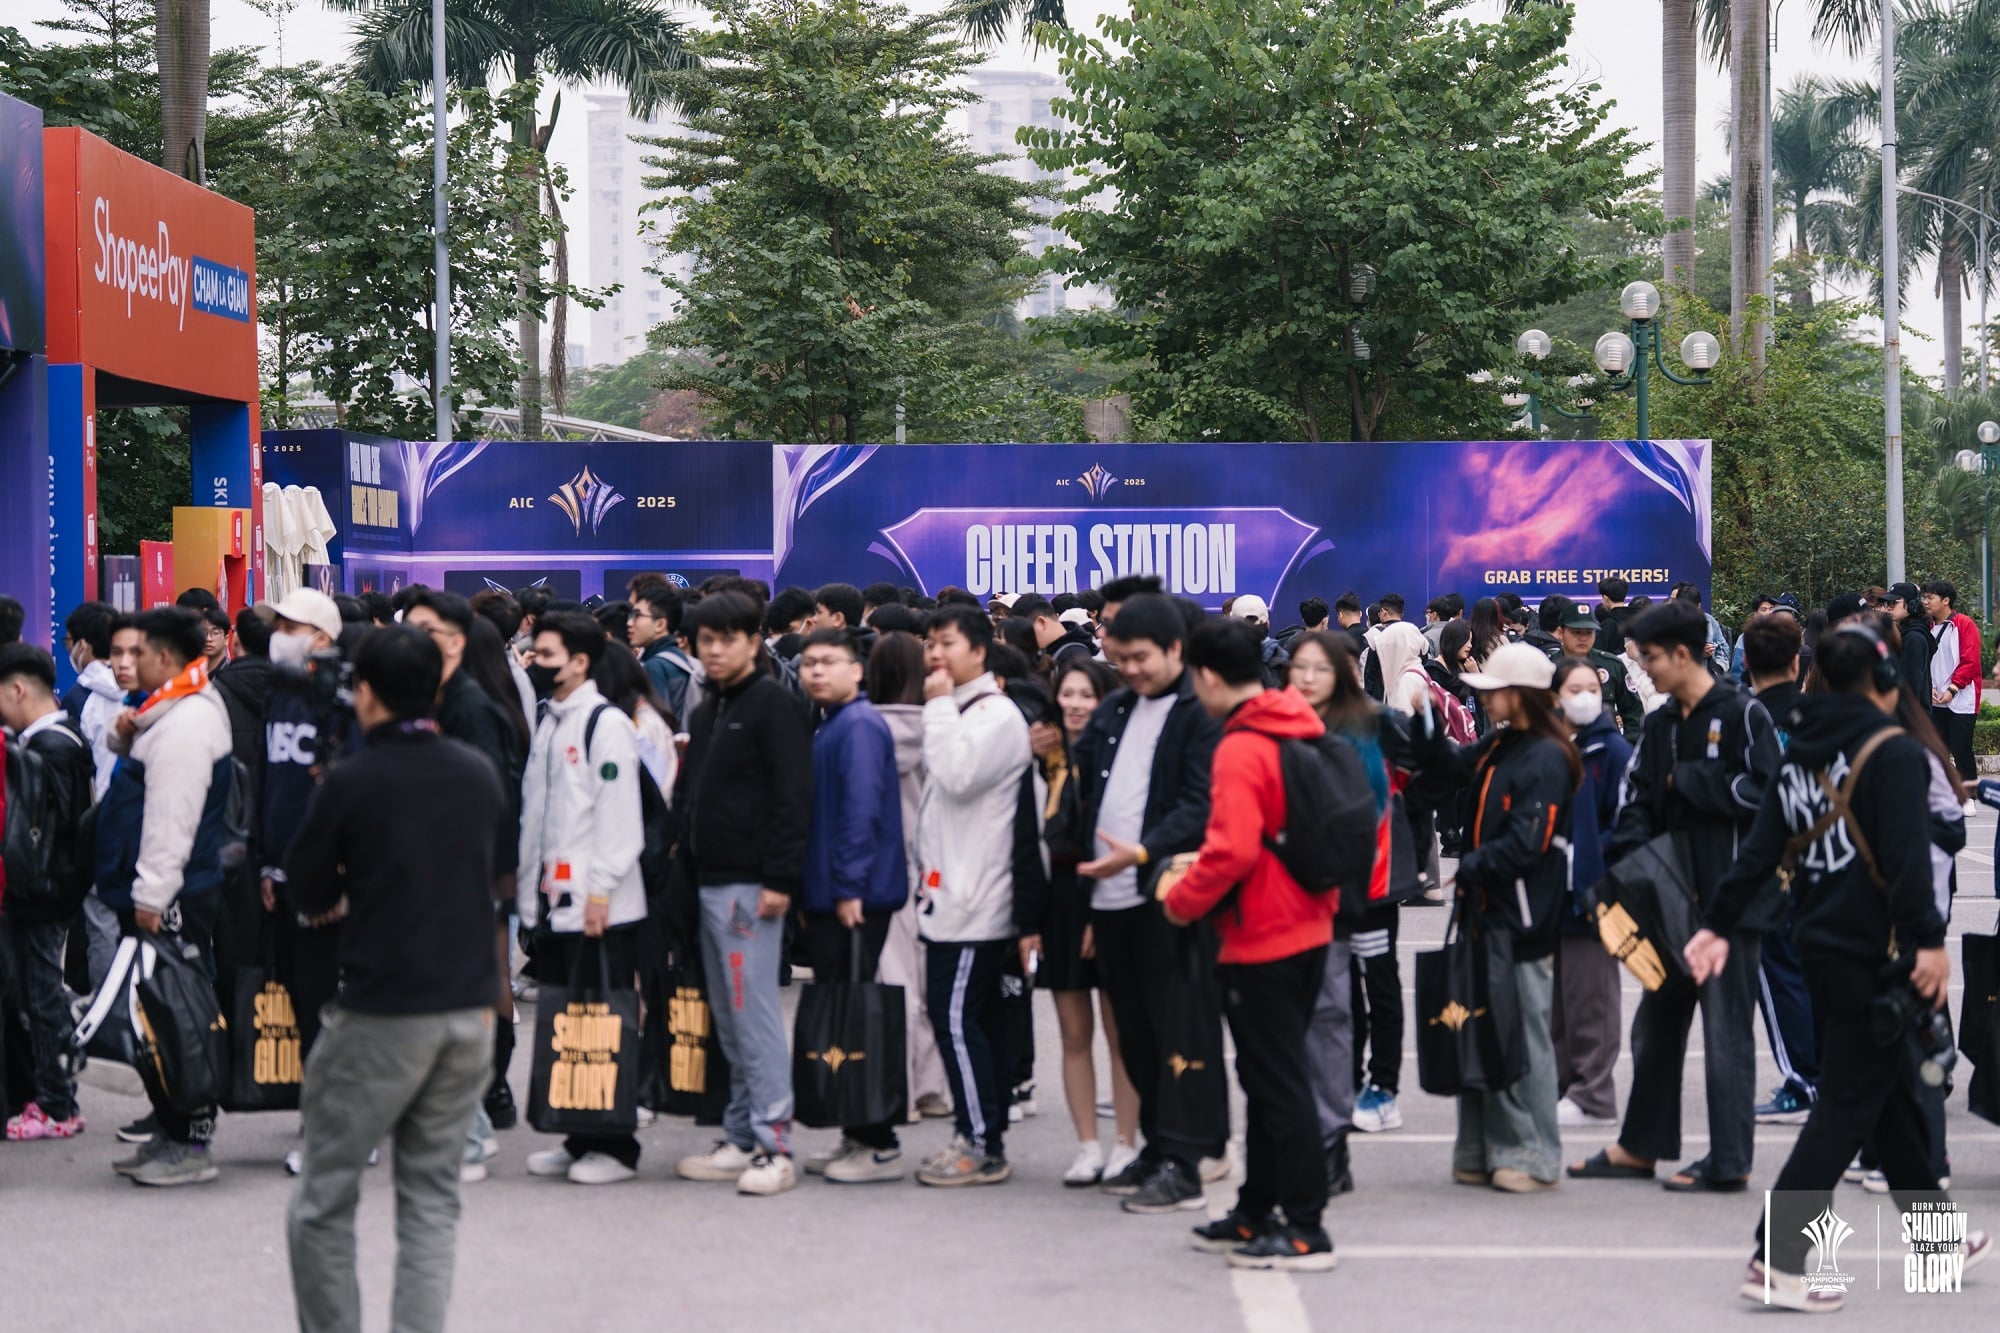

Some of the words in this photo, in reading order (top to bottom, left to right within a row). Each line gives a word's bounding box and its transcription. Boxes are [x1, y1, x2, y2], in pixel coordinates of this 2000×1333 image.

[94, 196, 189, 332] ShopeePay
[194, 264, 218, 313] CHẠM
[227, 265, 248, 315] GIẢM
[1124, 478, 1146, 486] 2025
[509, 497, 535, 509] AIC
[637, 496, 676, 508] 2025
[966, 524, 1078, 596] CHEER
[1089, 523, 1236, 594] STATION
[1484, 570, 1531, 584] GRAB
[1536, 570, 1578, 584] FREE
